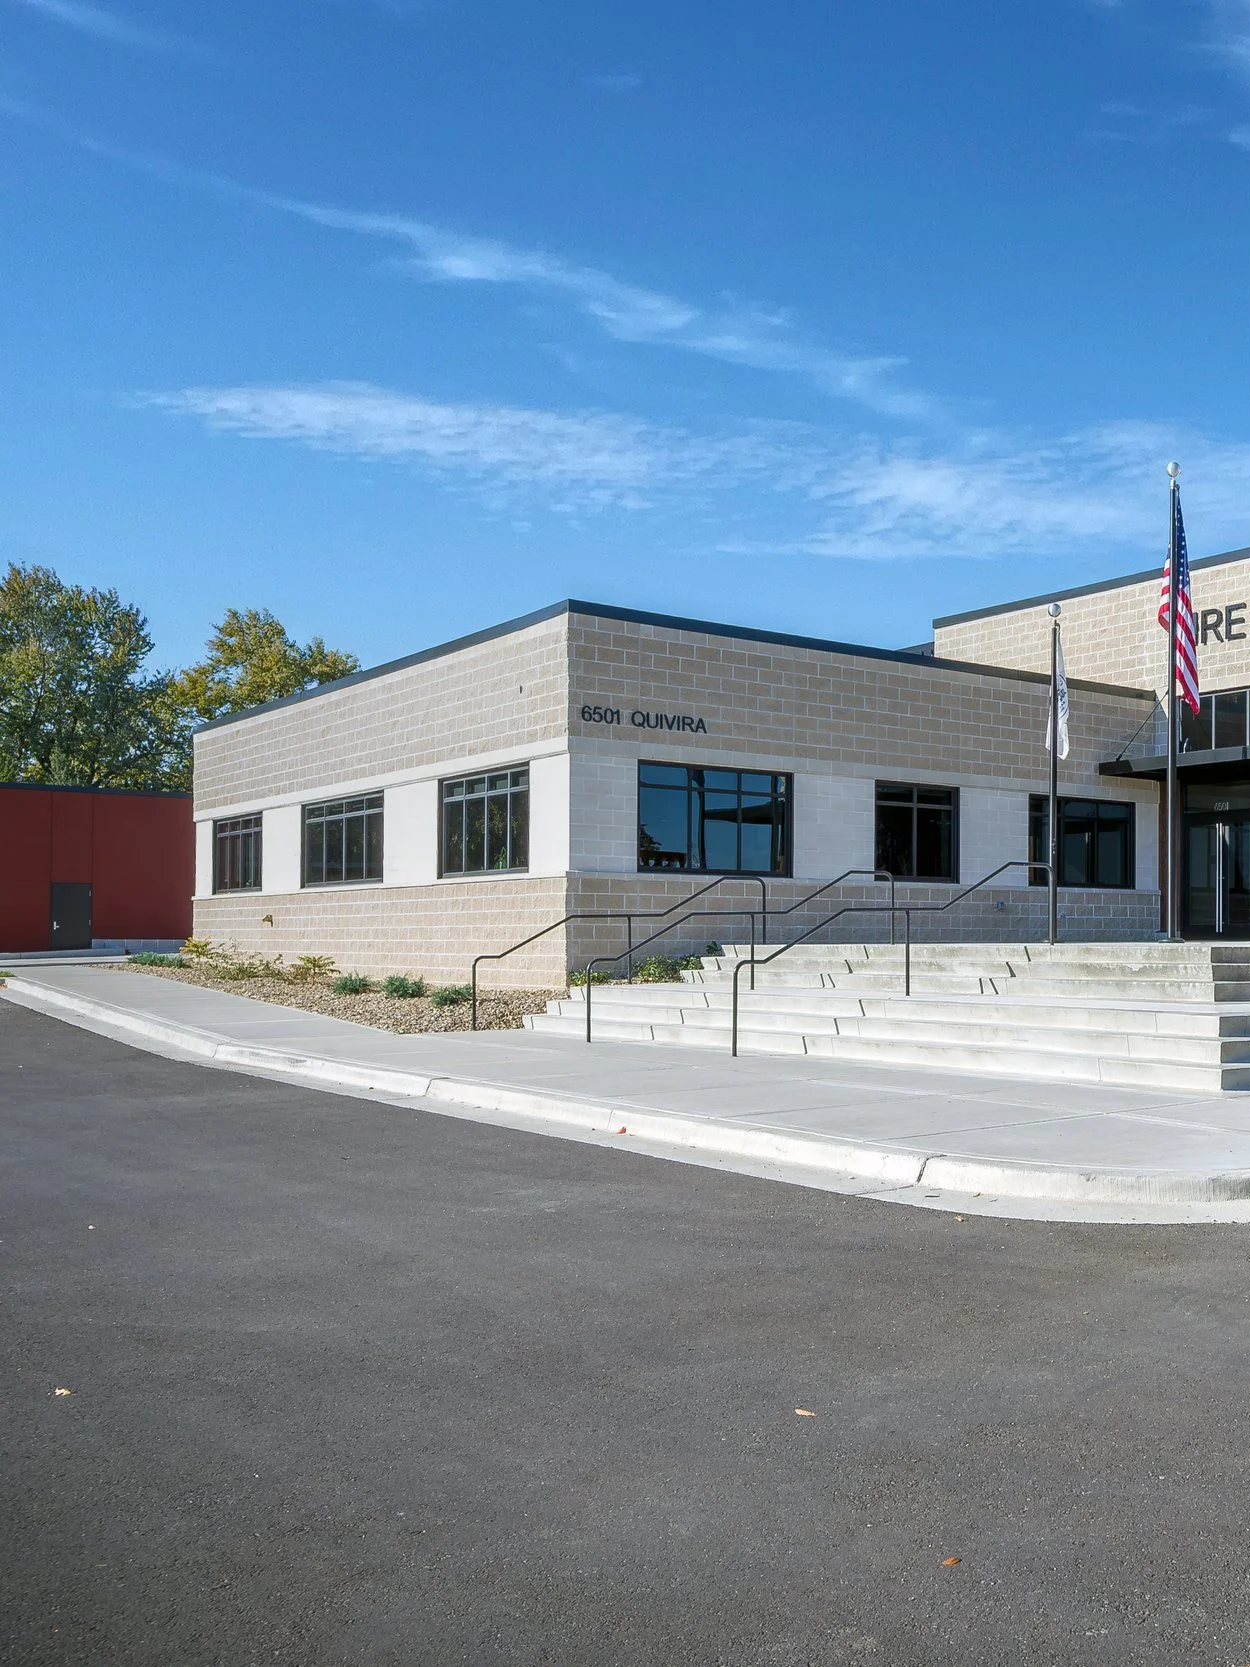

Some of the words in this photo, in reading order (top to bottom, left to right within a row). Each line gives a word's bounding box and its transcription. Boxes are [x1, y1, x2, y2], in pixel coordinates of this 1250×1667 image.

[1194, 602, 1247, 646] IRE
[581, 705, 621, 725] 6501
[631, 711, 708, 734] QUIVIRA
